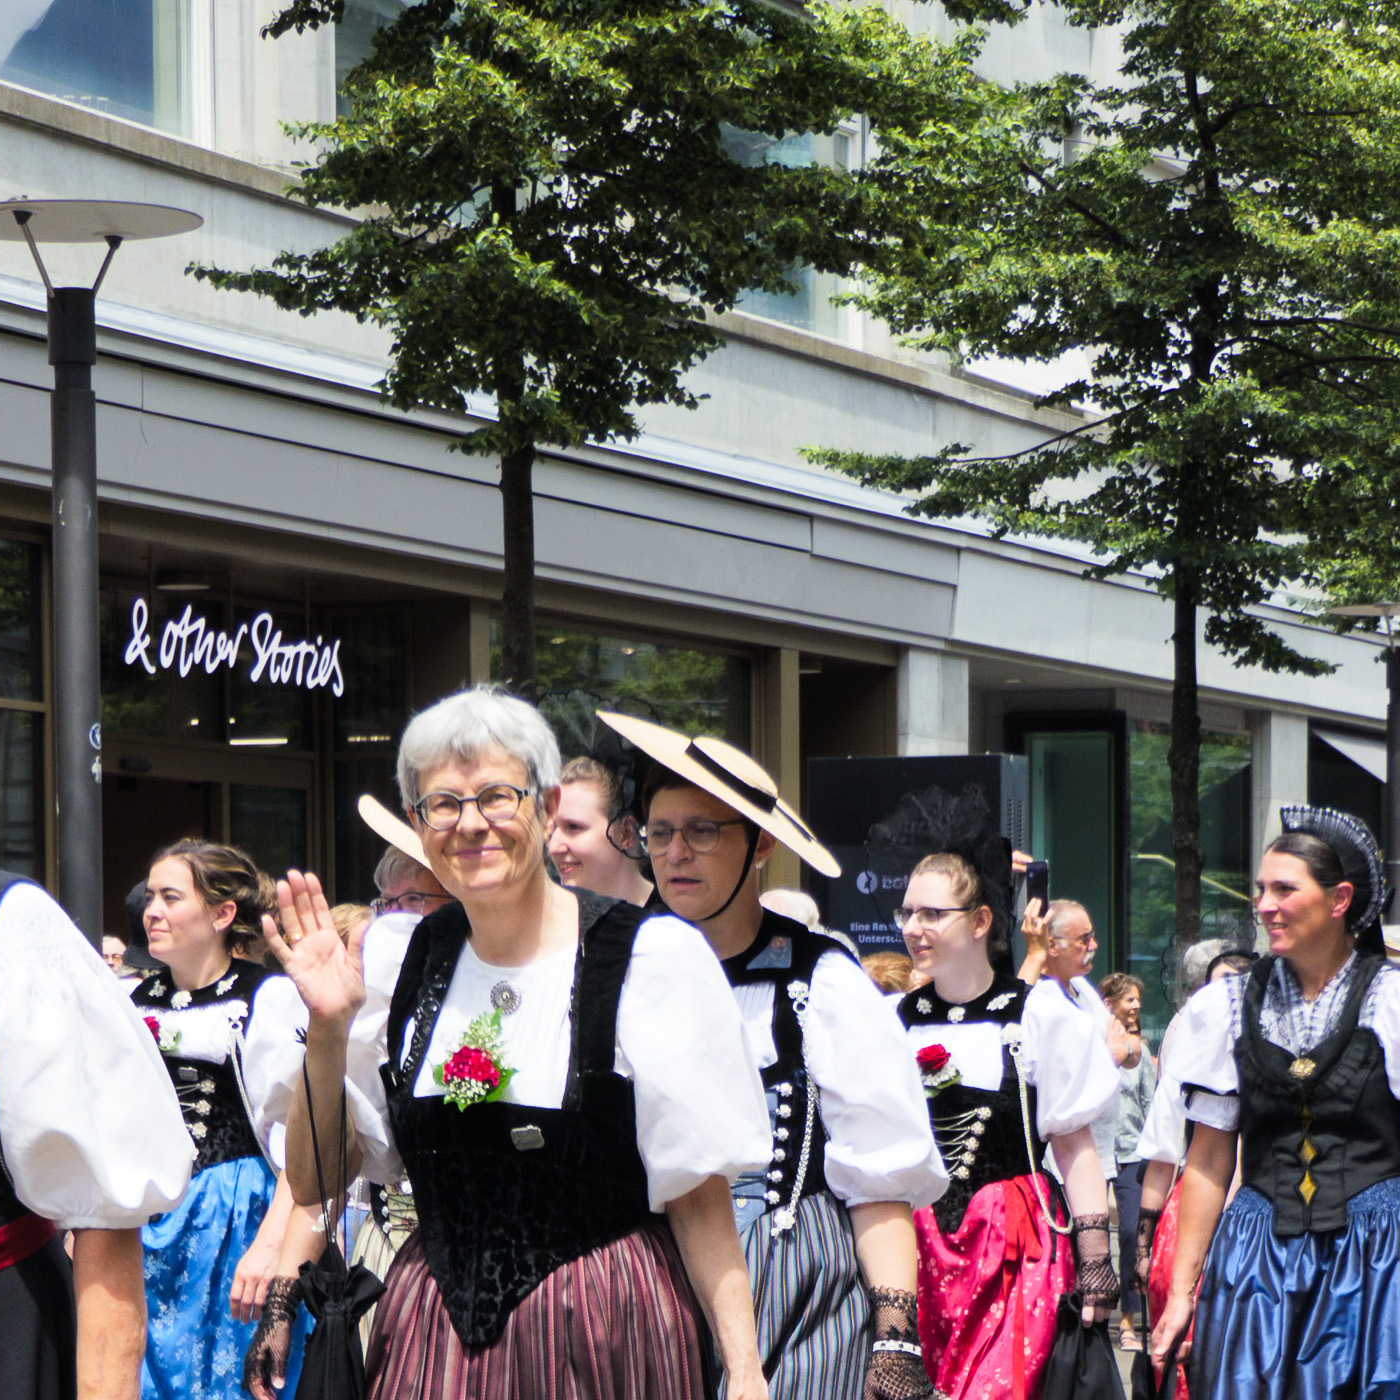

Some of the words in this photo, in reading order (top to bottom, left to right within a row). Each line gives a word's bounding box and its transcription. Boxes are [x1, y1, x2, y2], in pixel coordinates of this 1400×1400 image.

[125, 598, 156, 675] &
[250, 612, 344, 698] Stories
[850, 922, 870, 932] Eine
